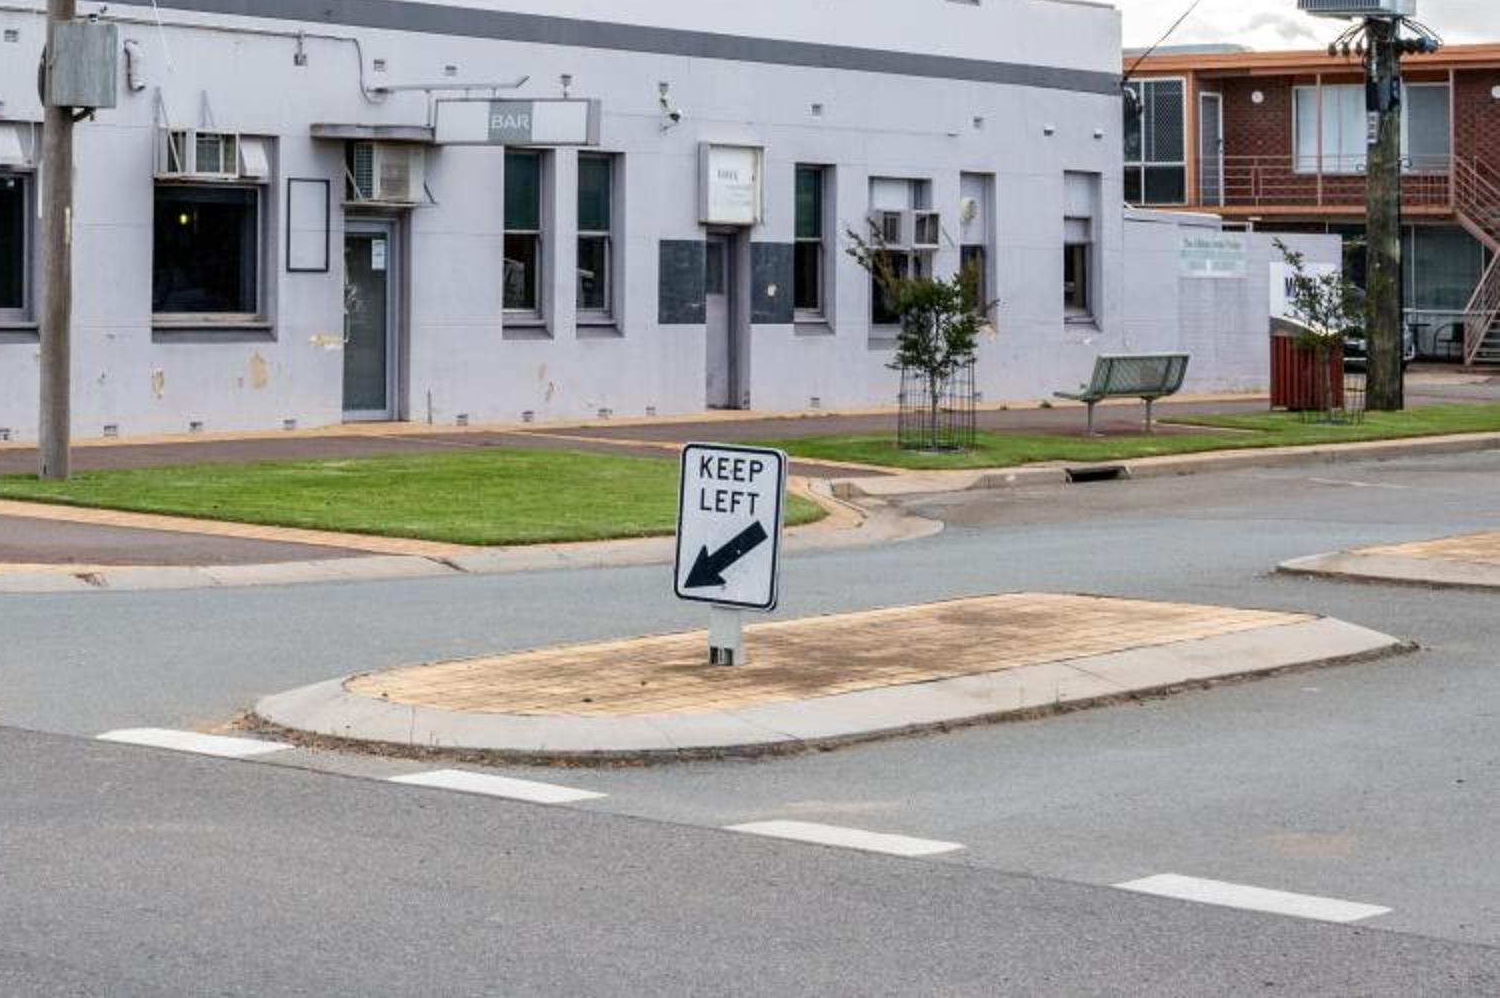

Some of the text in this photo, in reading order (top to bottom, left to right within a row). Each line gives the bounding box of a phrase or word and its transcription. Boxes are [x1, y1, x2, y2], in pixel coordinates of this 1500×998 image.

[490, 113, 530, 130] BAR
[699, 455, 764, 483] KEEP
[699, 487, 760, 516] LEFT
